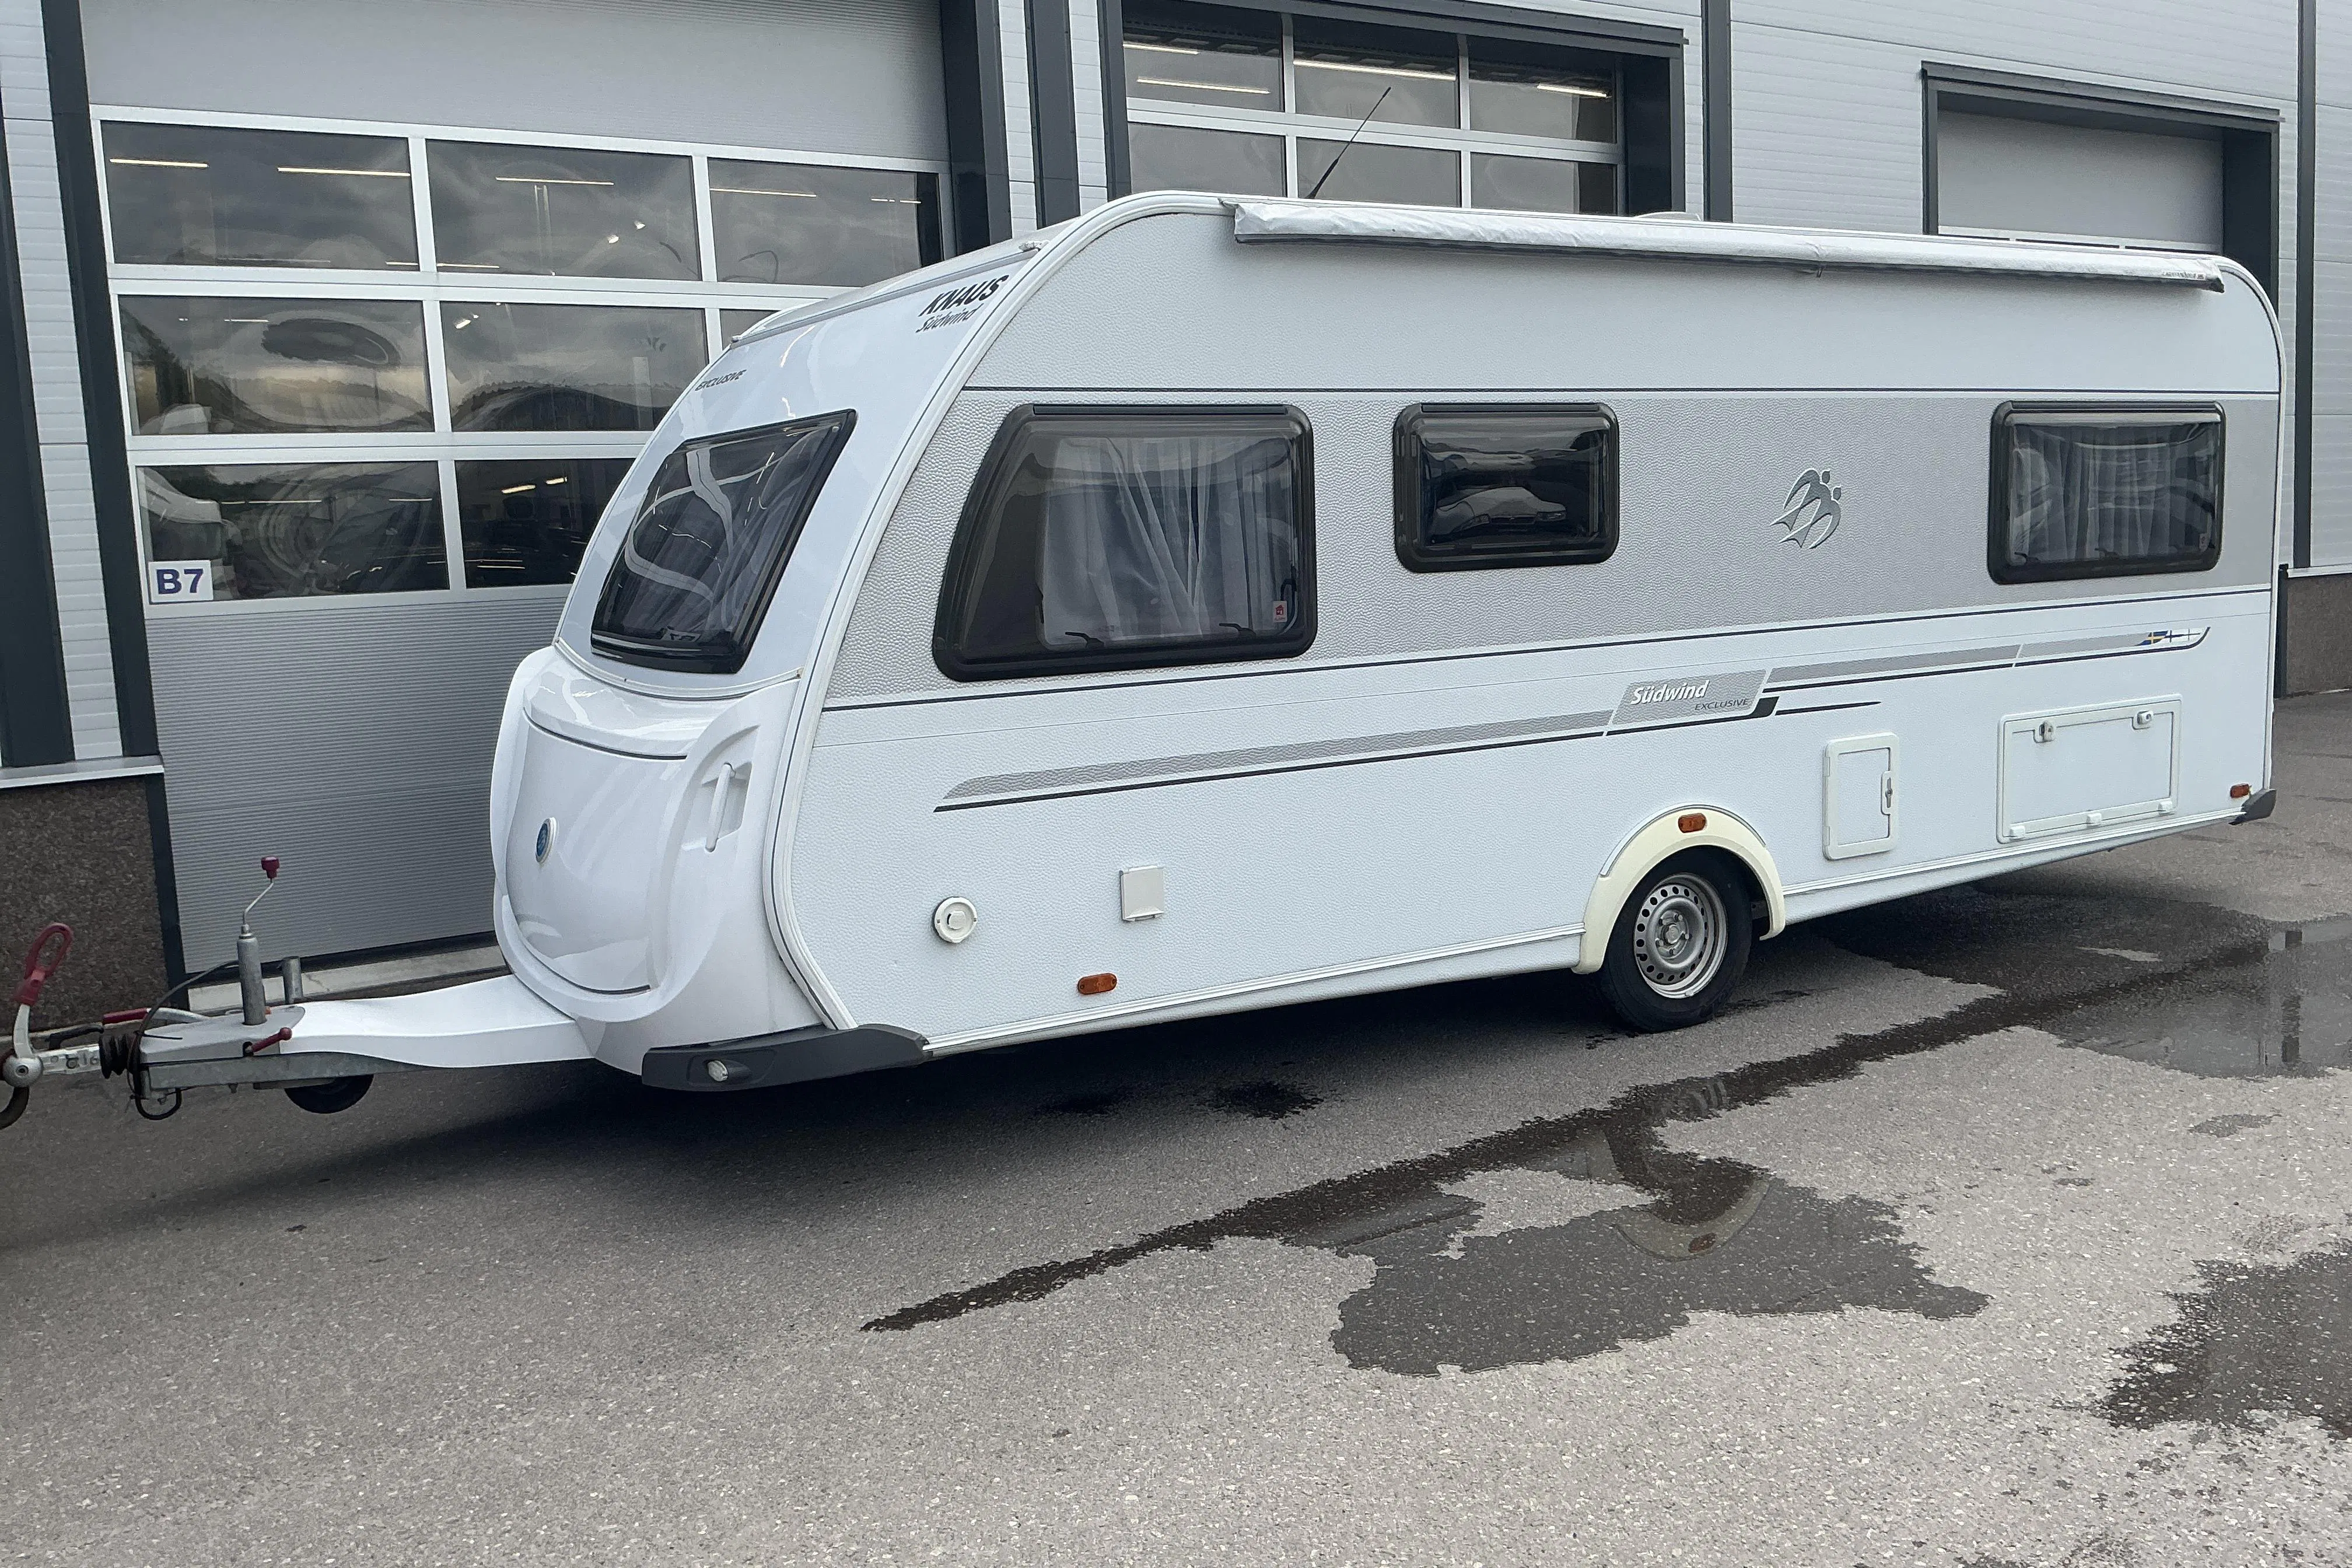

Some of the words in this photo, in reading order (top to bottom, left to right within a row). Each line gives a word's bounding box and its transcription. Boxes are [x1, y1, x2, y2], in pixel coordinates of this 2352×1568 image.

[918, 274, 1010, 317] KNAUS
[915, 302, 985, 333] Südwind
[156, 568, 204, 594] B7
[1630, 679, 1710, 705] Südwind
[1695, 698, 1750, 711] EXCLUSIVE
